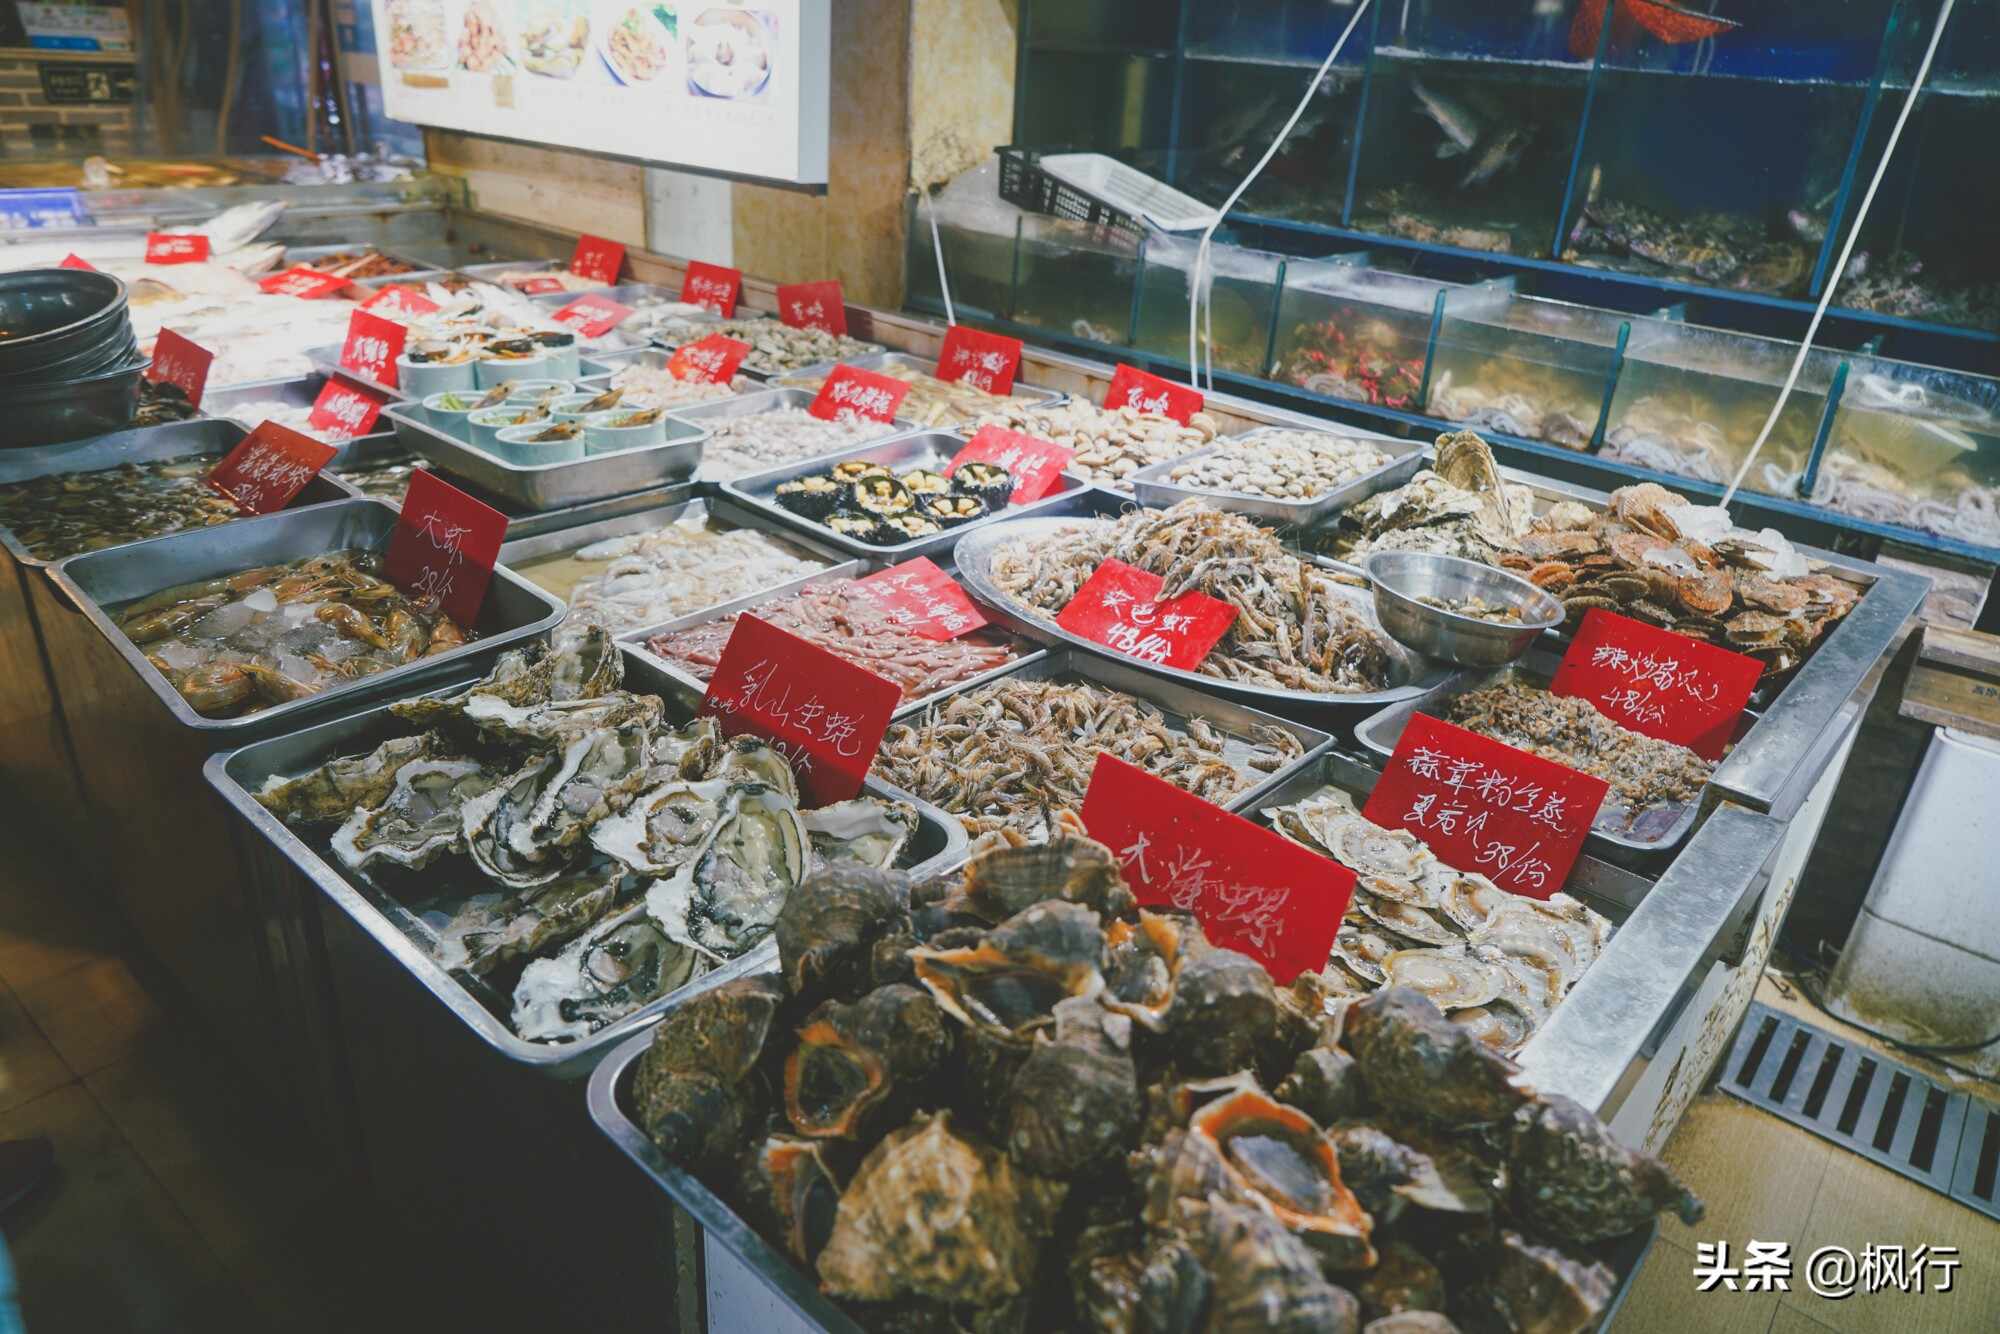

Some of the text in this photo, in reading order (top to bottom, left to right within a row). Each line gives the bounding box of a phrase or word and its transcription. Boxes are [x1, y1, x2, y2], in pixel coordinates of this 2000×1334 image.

[416, 509, 473, 566] 大虾
[739, 658, 866, 758] 乳山生蚝
[1474, 841, 1553, 889] 38/份
